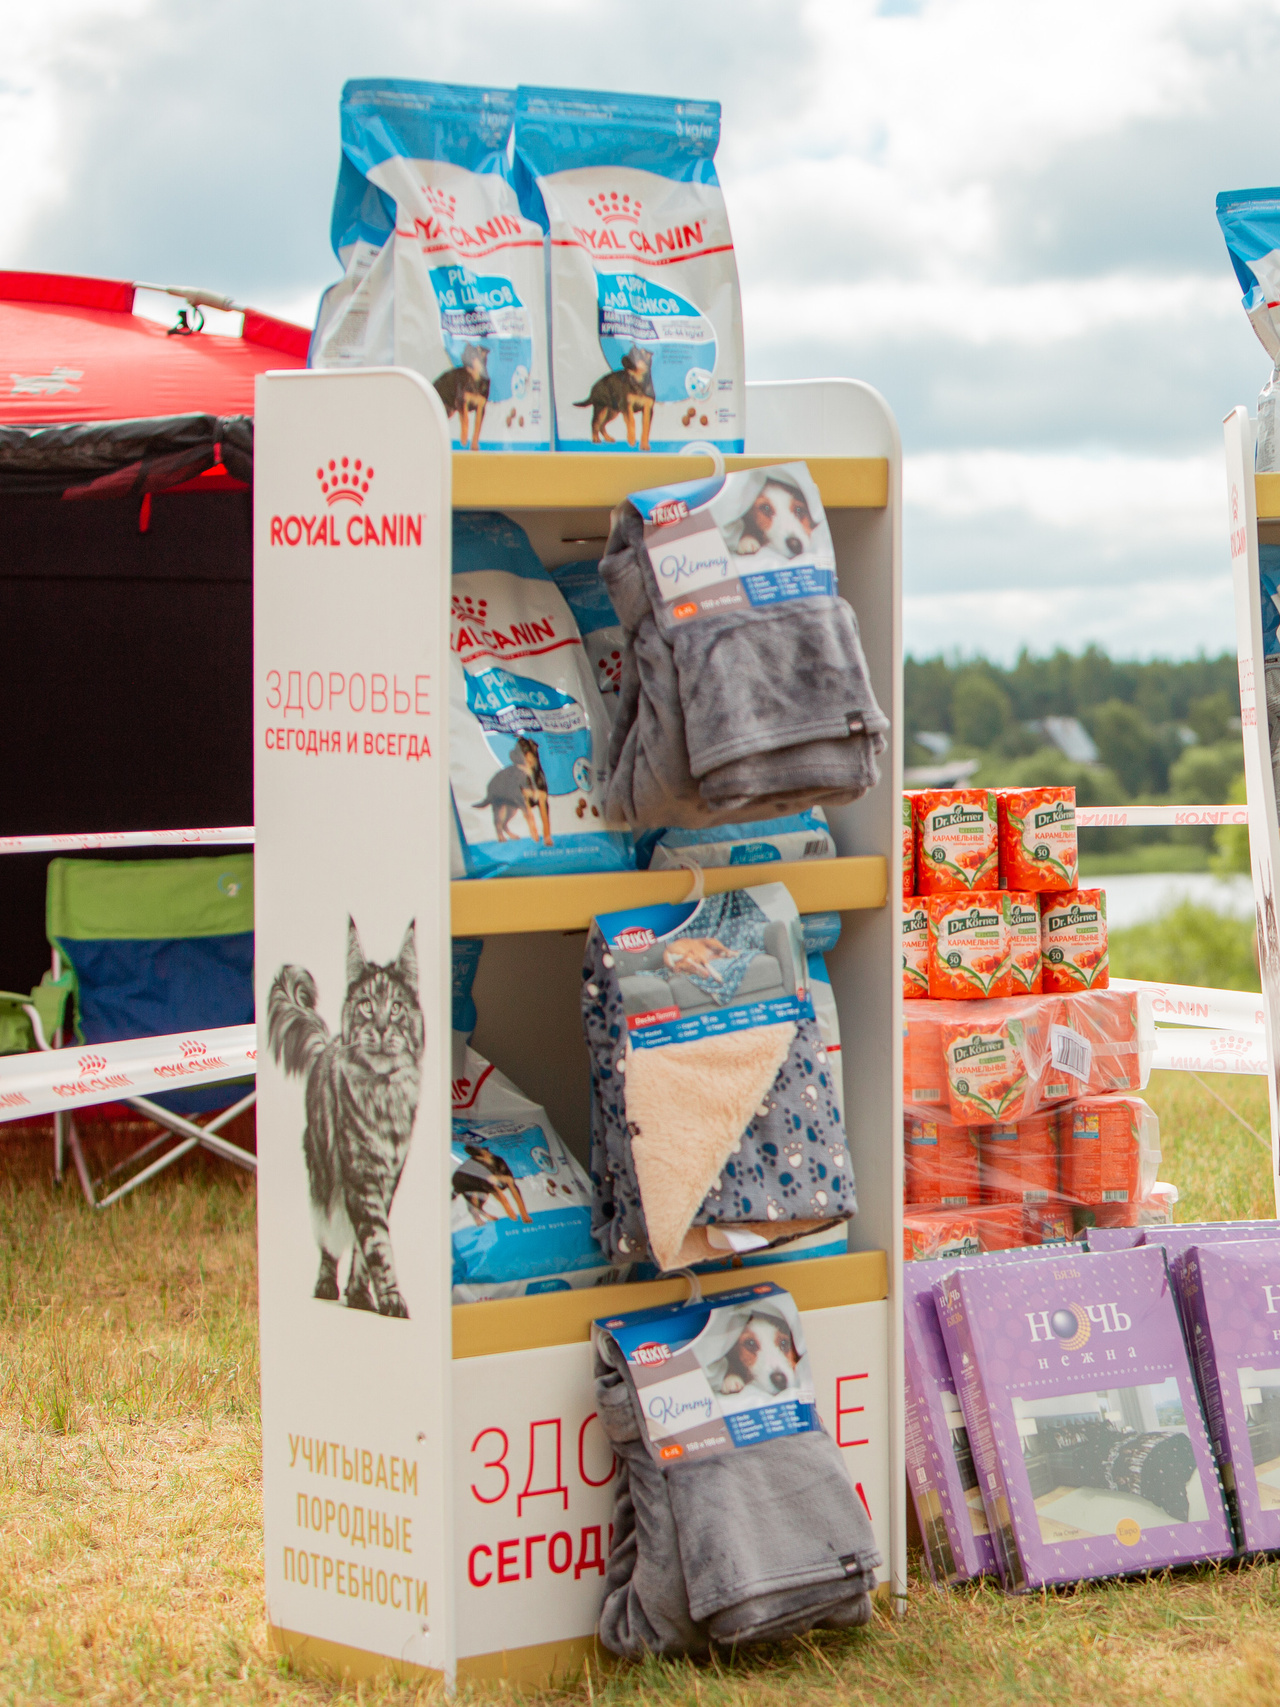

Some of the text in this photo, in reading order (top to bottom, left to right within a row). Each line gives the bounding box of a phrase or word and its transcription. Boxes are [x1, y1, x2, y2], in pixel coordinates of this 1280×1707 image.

[450, 215, 521, 247] CANIN
[628, 221, 703, 255] CANIN
[270, 514, 422, 546] ROYAL CANIN
[659, 555, 729, 584] Kimmy
[481, 617, 555, 649] CANIN
[265, 669, 431, 719] ЗДОРОВЬЕ
[265, 727, 431, 762] СЕГОДНЯ И ВСЕГДА
[936, 813, 982, 829] Dr. Körner
[1038, 815, 1052, 826] Dr.
[1038, 849, 1047, 857] 30
[951, 917, 997, 932] Dr. Körner
[1011, 915, 1035, 924] Körner
[1052, 913, 1096, 929] Dr. Körner
[614, 929, 657, 951] TRIXIE
[1152, 998, 1209, 1018] CANIN
[956, 1042, 1002, 1060] Dr. Körner
[154, 1056, 230, 1079] ROYAL CANIN
[52, 1074, 134, 1098] ROYAL CANIN
[1025, 1302, 1132, 1346] НОЧЬ
[631, 1344, 672, 1366] TRIXIE
[1039, 1347, 1137, 1370] нежна
[649, 1396, 713, 1425] Kimmy
[288, 1432, 418, 1497] УЧИТЫВАЕМ
[297, 1492, 413, 1555] ПОРОДНЫЕ
[467, 1523, 614, 1589] СЕГОД
[283, 1546, 428, 1617] ПОТРЕБНОСТИ
